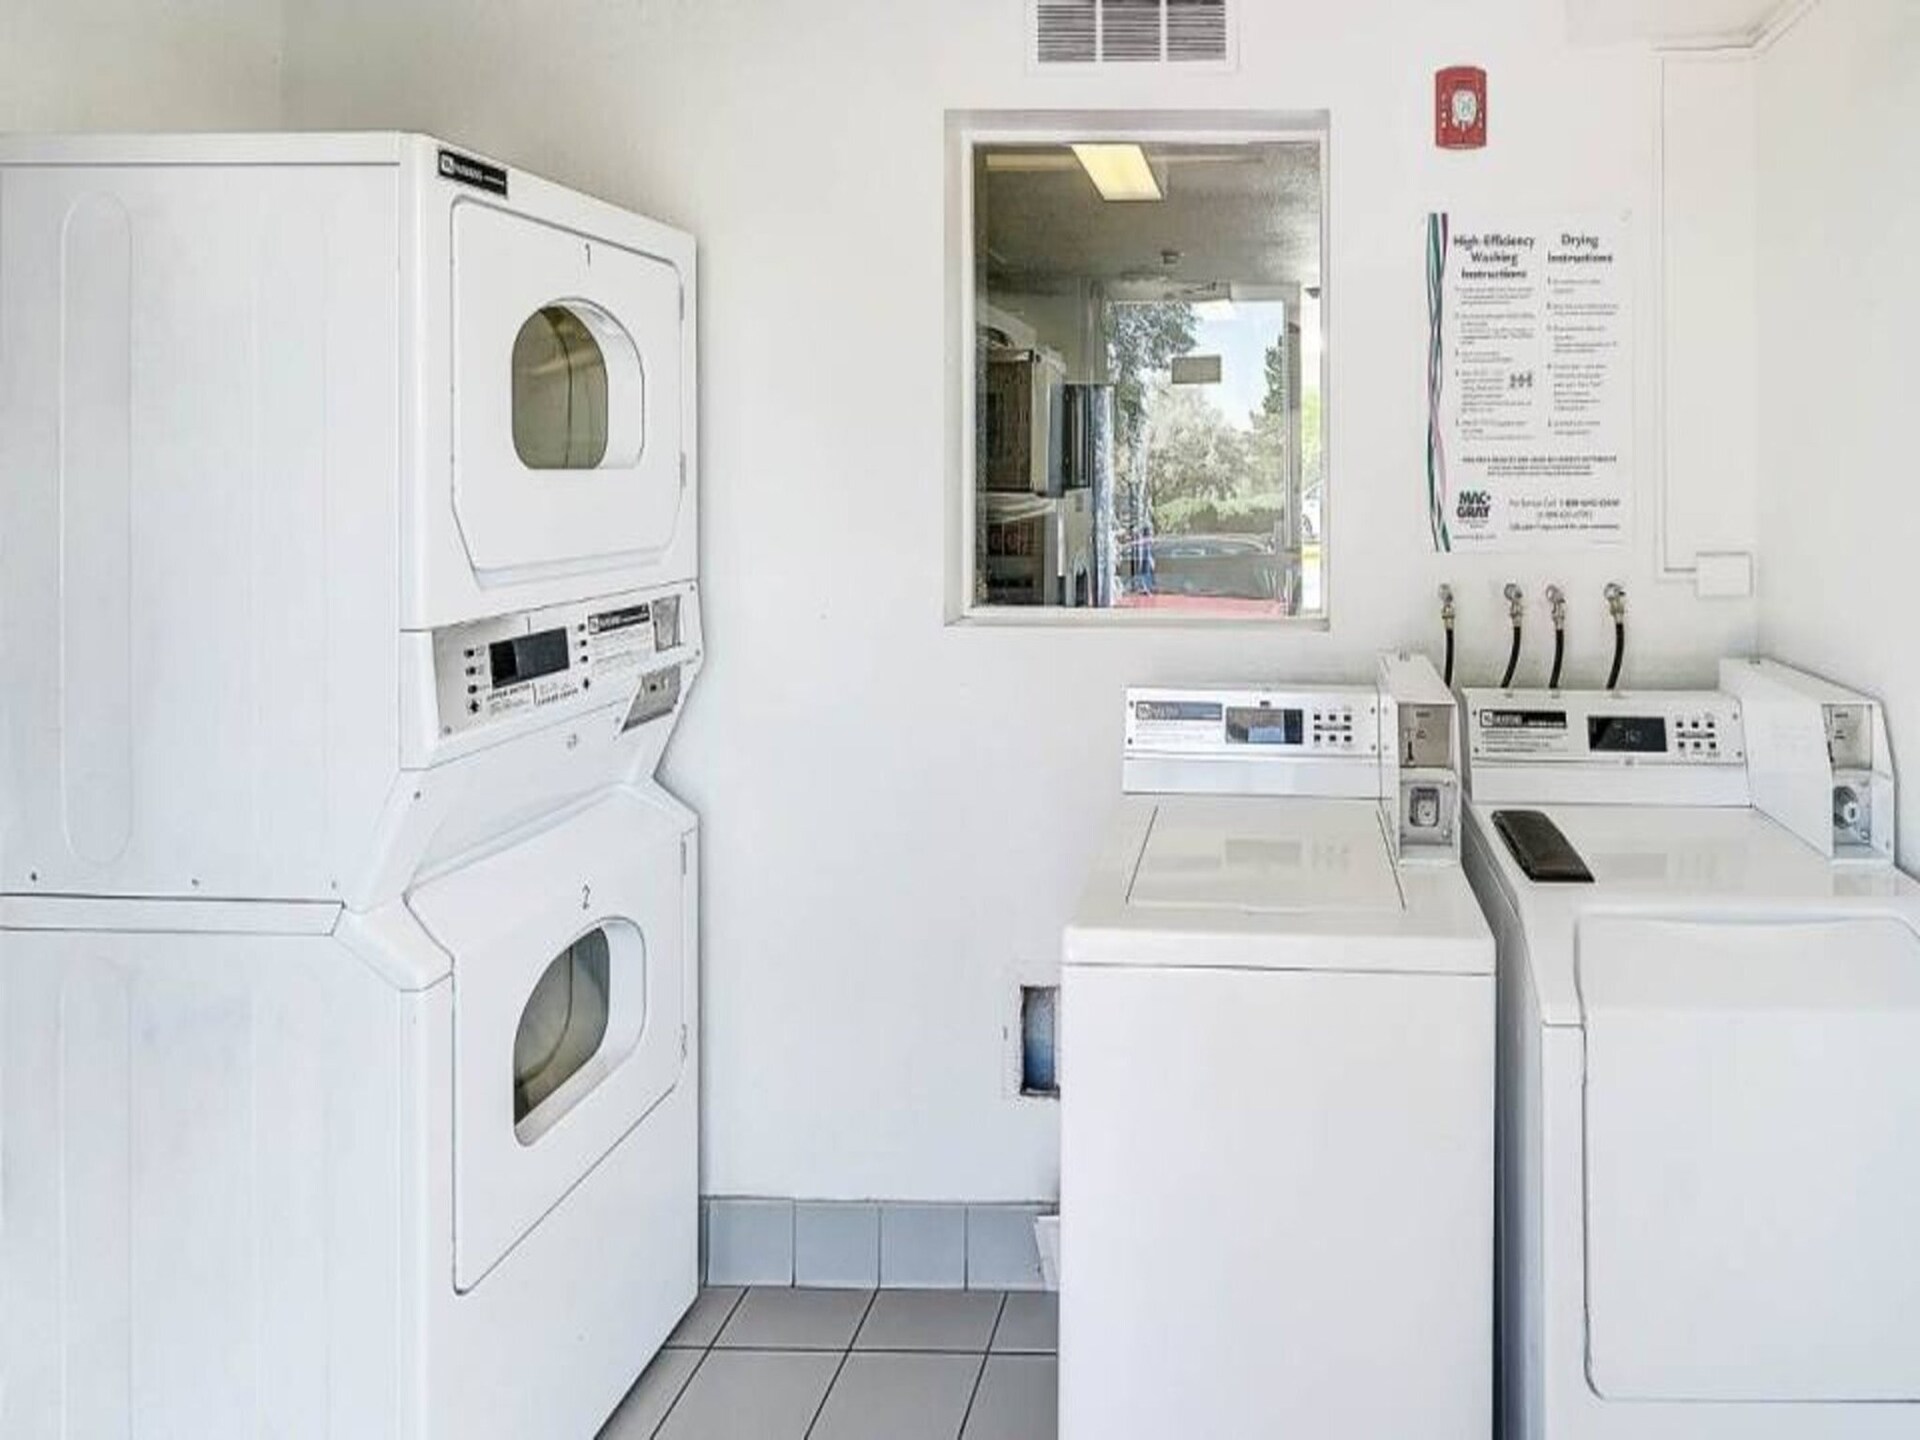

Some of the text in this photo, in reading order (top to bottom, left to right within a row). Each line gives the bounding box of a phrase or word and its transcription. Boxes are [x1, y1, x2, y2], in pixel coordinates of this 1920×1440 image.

[1561, 233, 1599, 250] Drying
[1471, 251, 1519, 268] Washing
[1547, 251, 1613, 263] Instructions
[1461, 267, 1527, 279] Instructions
[1456, 505, 1490, 518] GRAY
[582, 884, 591, 910] 2
